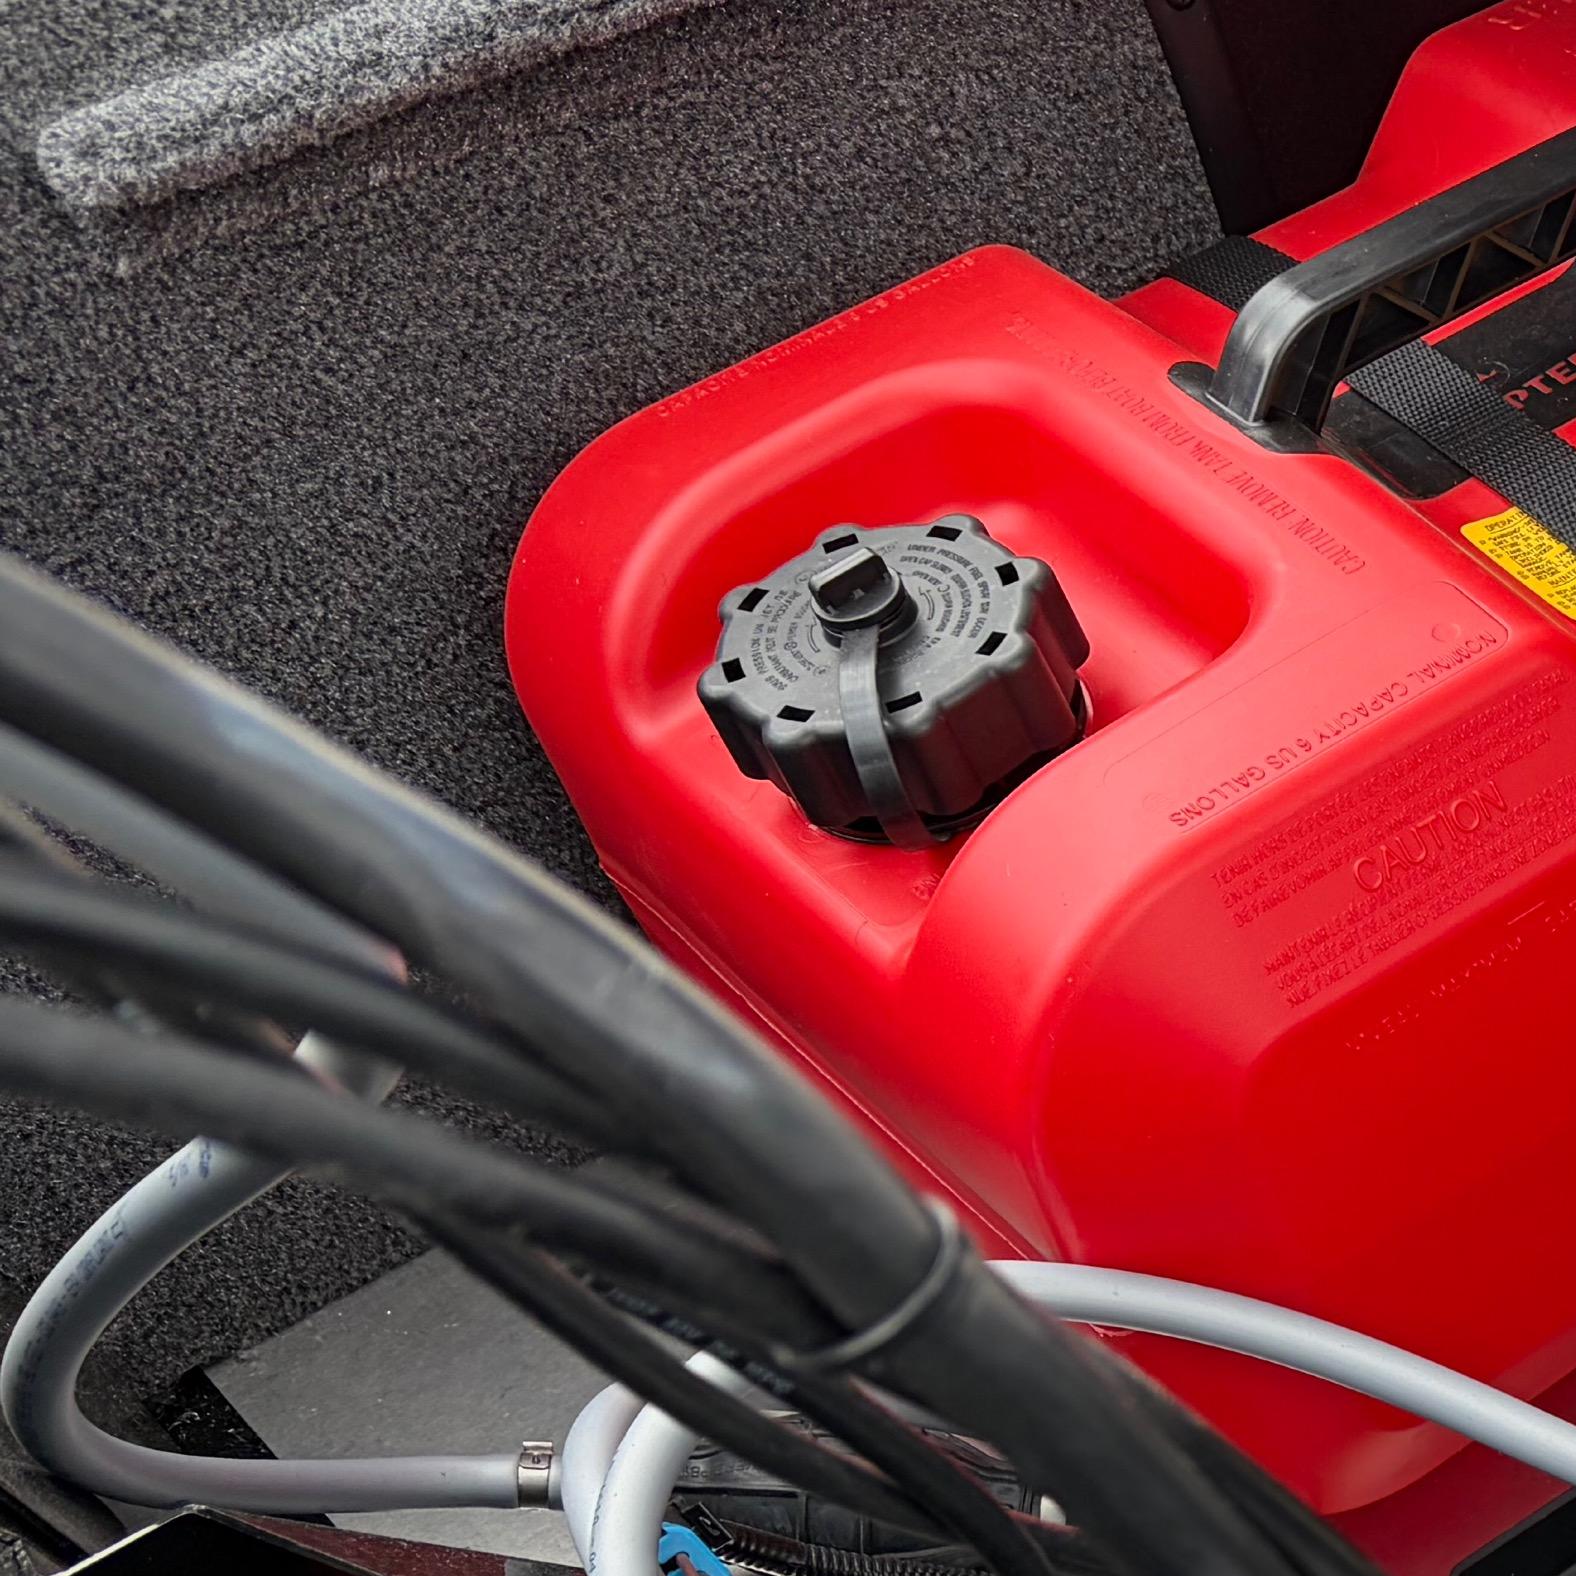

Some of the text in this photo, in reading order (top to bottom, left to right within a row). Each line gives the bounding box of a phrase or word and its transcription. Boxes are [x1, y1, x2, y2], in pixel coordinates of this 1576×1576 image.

[1406, 630, 1497, 682] NOMINAL
[1312, 679, 1413, 743] CAPACITY
[1266, 743, 1297, 776] US
[1168, 761, 1267, 830] GALLONS
[1351, 780, 1509, 893] CAUTION
